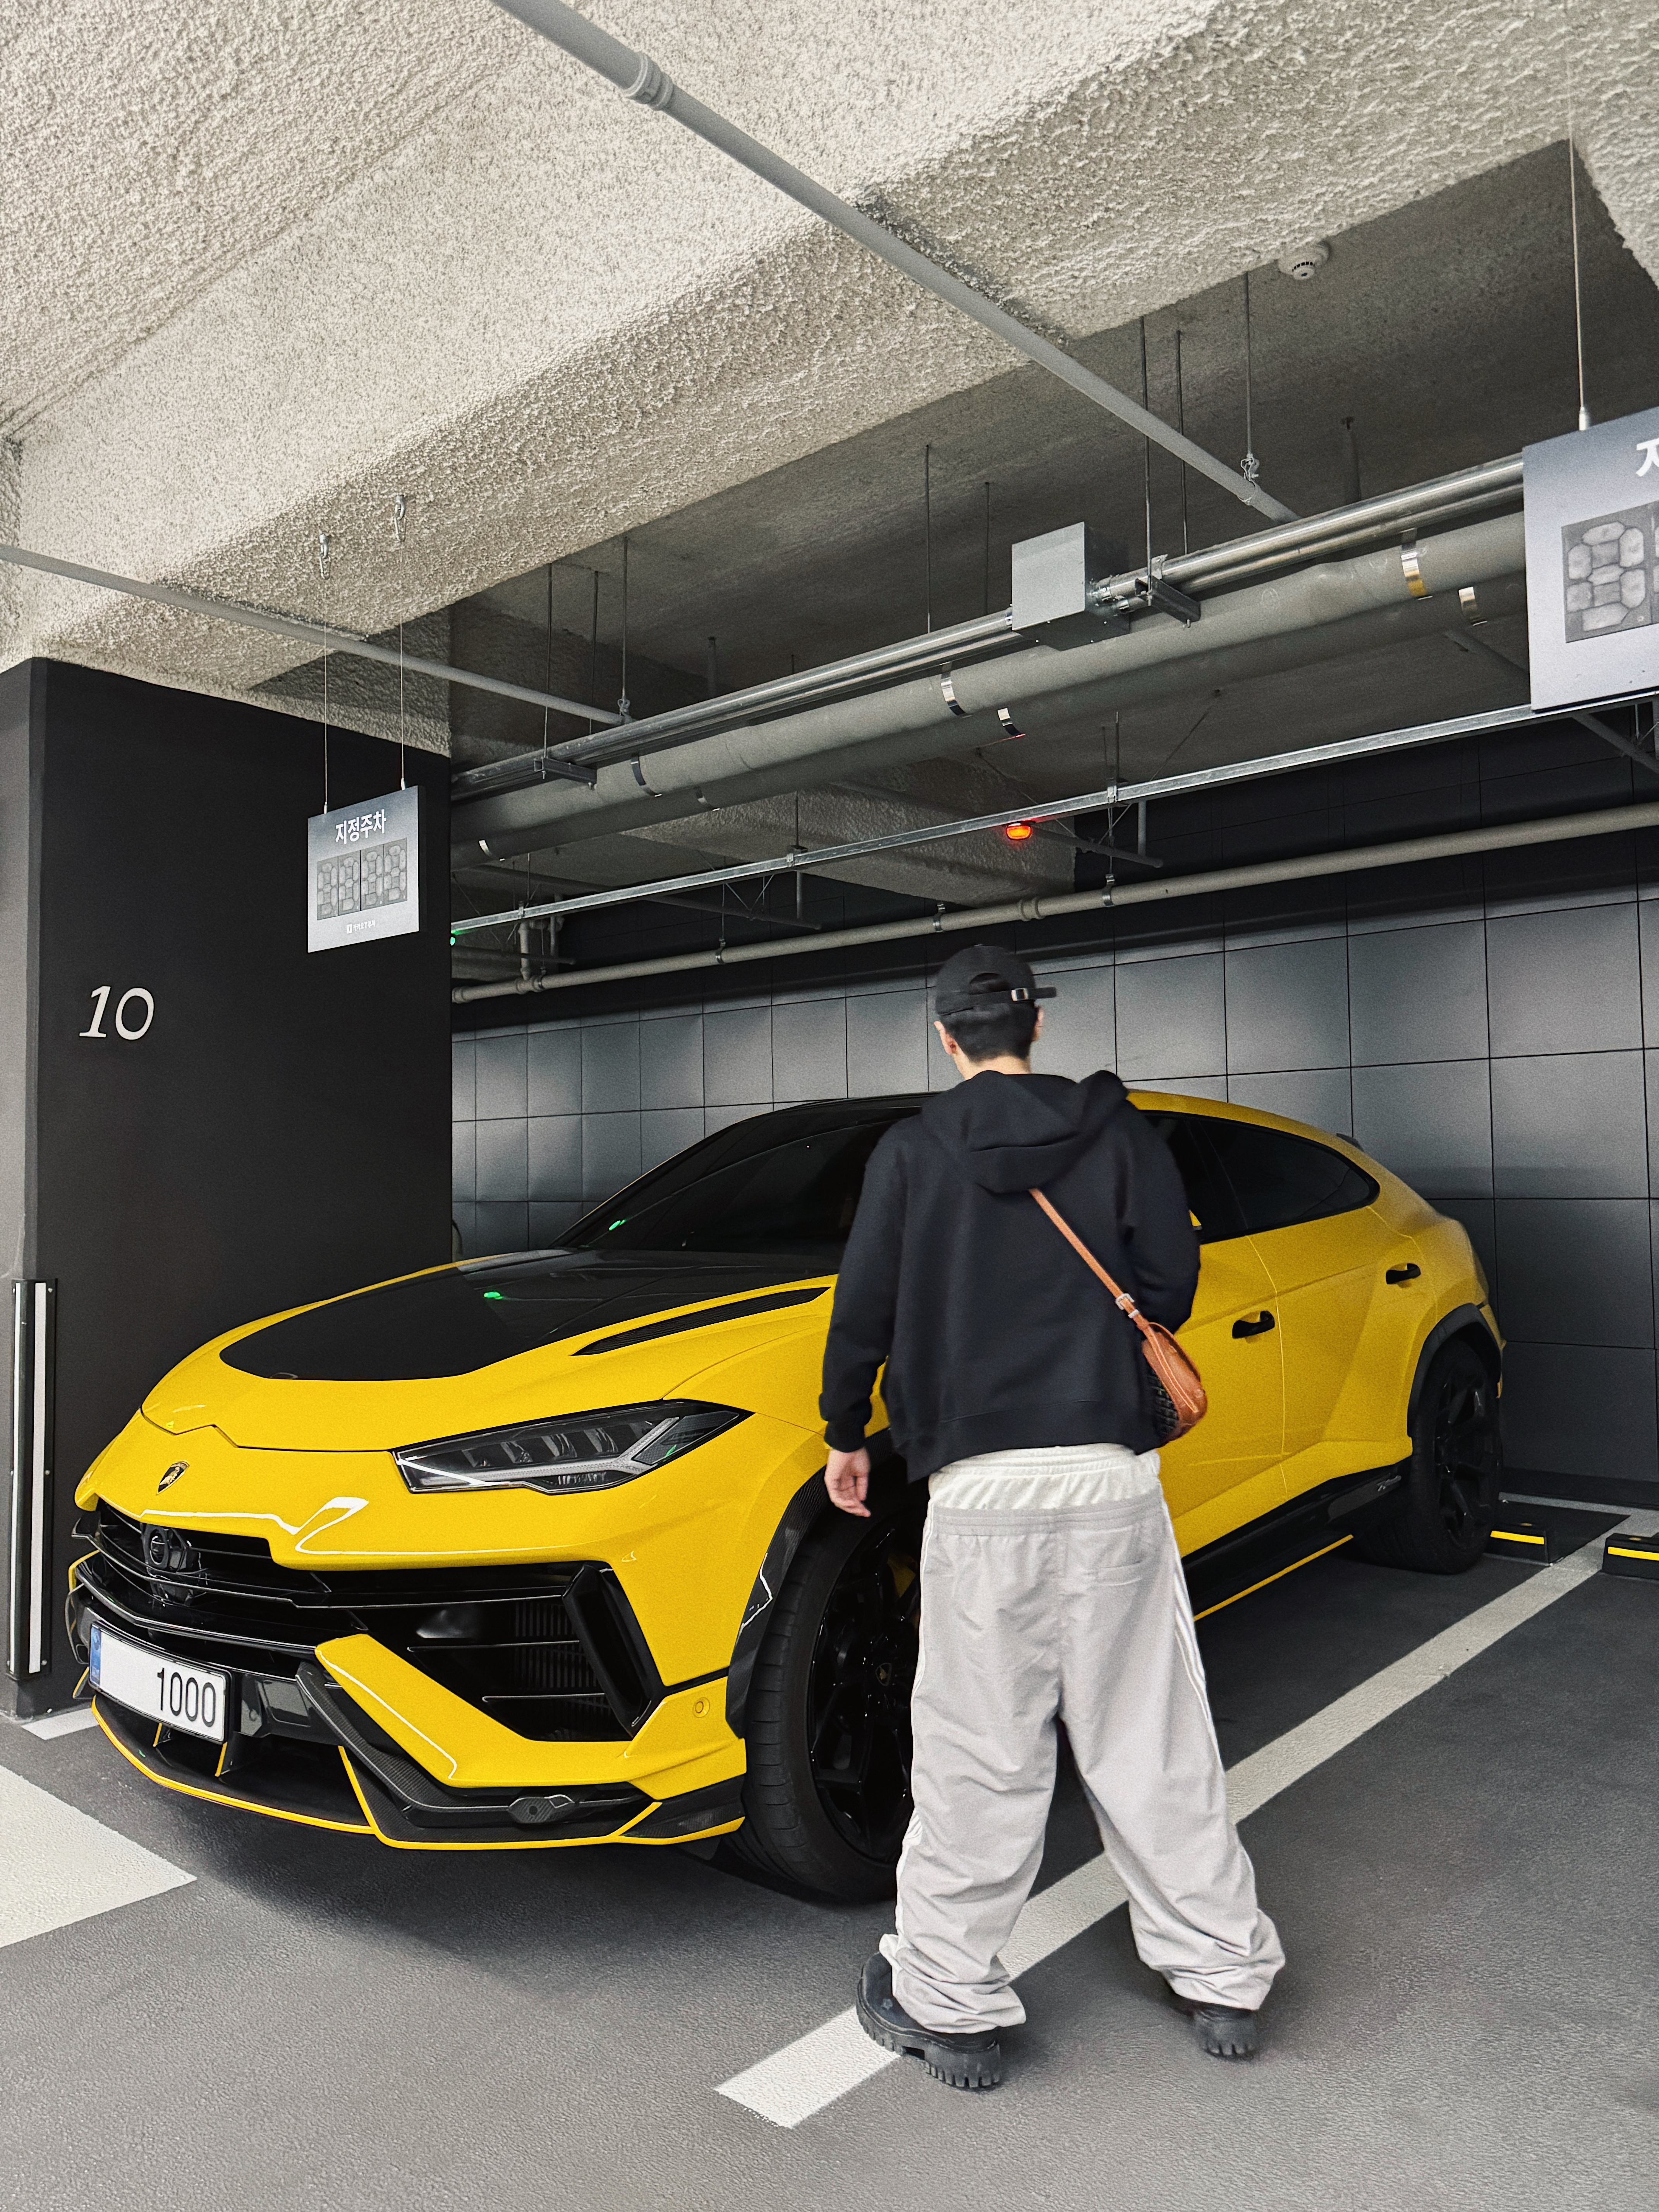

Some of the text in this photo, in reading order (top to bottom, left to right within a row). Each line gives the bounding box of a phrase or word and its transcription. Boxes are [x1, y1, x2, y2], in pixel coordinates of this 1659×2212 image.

[335, 809, 386, 844] 지정주차
[79, 986, 154, 1040] 10
[157, 1667, 216, 1727] 1000
